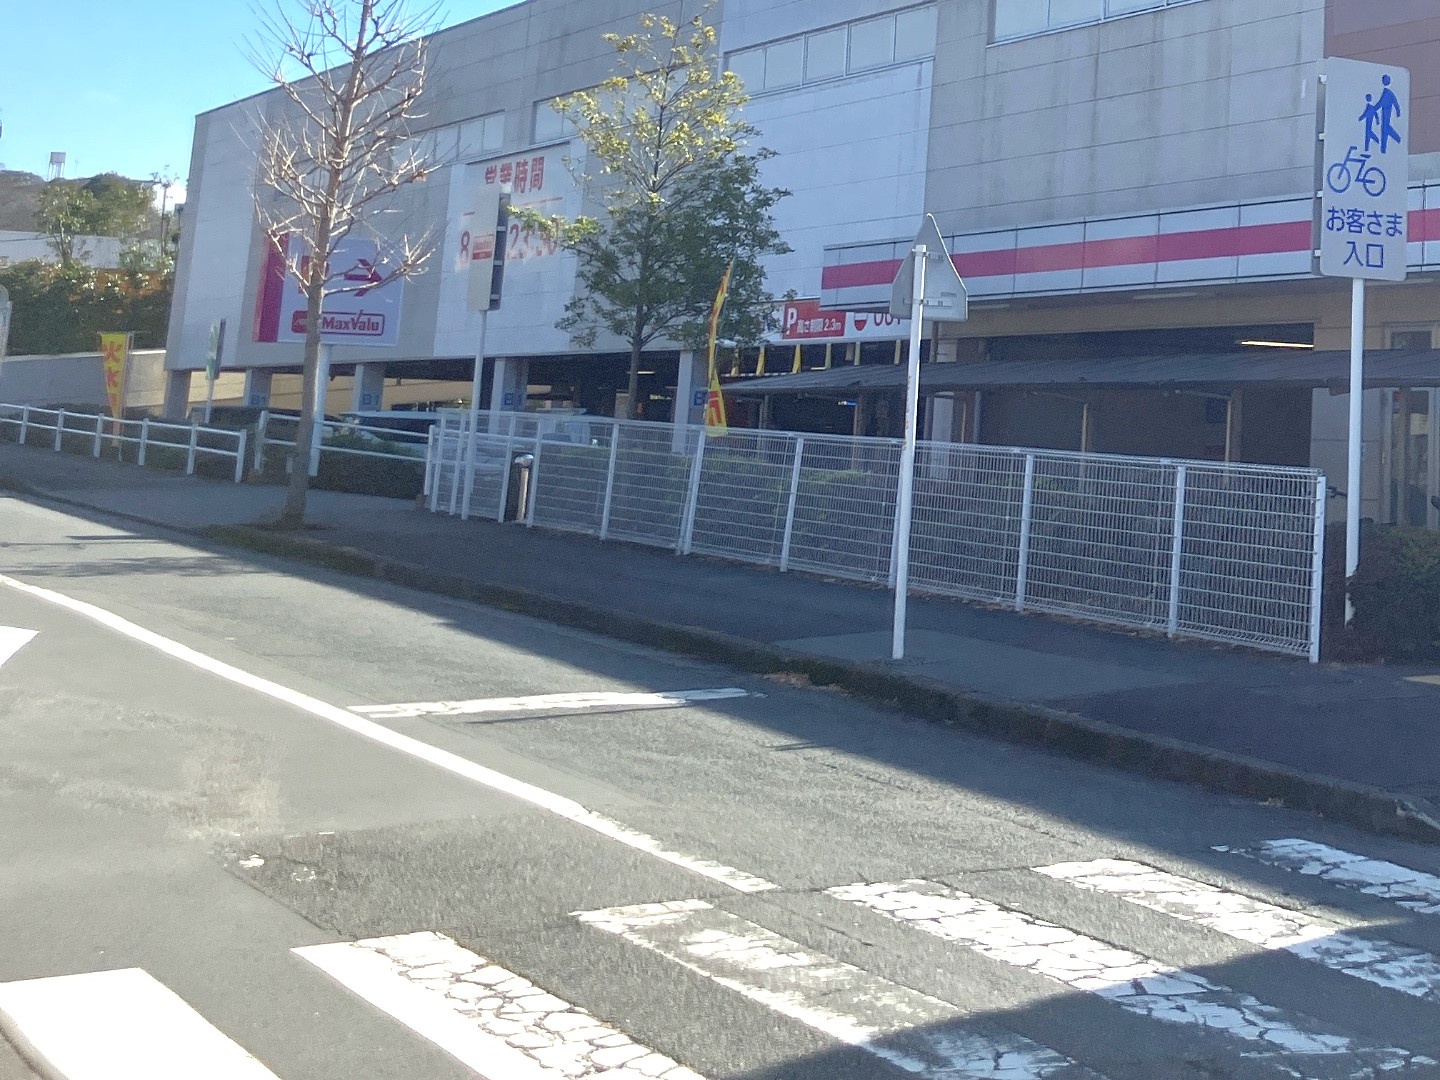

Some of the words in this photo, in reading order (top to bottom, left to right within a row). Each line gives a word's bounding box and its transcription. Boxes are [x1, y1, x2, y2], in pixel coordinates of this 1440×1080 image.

[1326, 205, 1403, 237] お客さま
[1343, 241, 1384, 269] 入口
[321, 309, 380, 332] MaxValu
